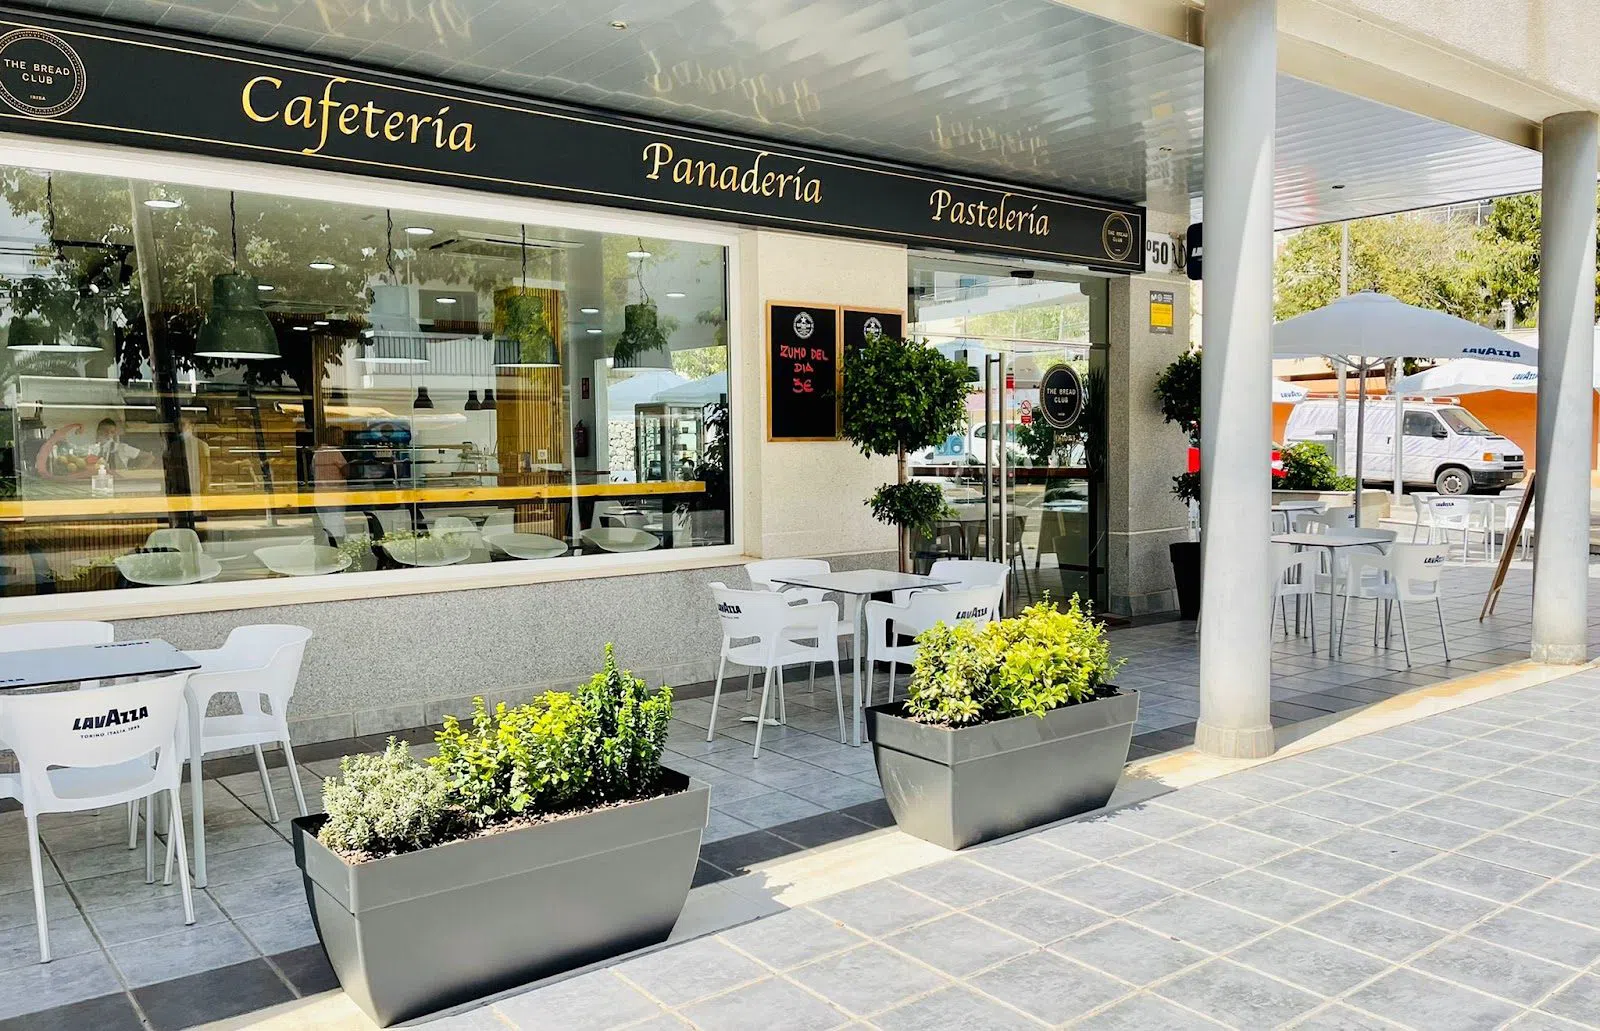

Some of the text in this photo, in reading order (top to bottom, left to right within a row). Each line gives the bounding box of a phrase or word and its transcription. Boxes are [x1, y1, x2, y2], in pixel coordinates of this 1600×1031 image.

[4, 58, 70, 76] THE BREAD
[22, 72, 53, 85] CLUB
[241, 75, 477, 154] Cafetería
[642, 142, 823, 204] Panadería
[929, 189, 1050, 236] Pastelería
[780, 345, 829, 361] ZUMO DEL
[793, 362, 814, 373] DIA
[1053, 396, 1069, 404] CLUB
[72, 706, 149, 731] LAVAZZA
